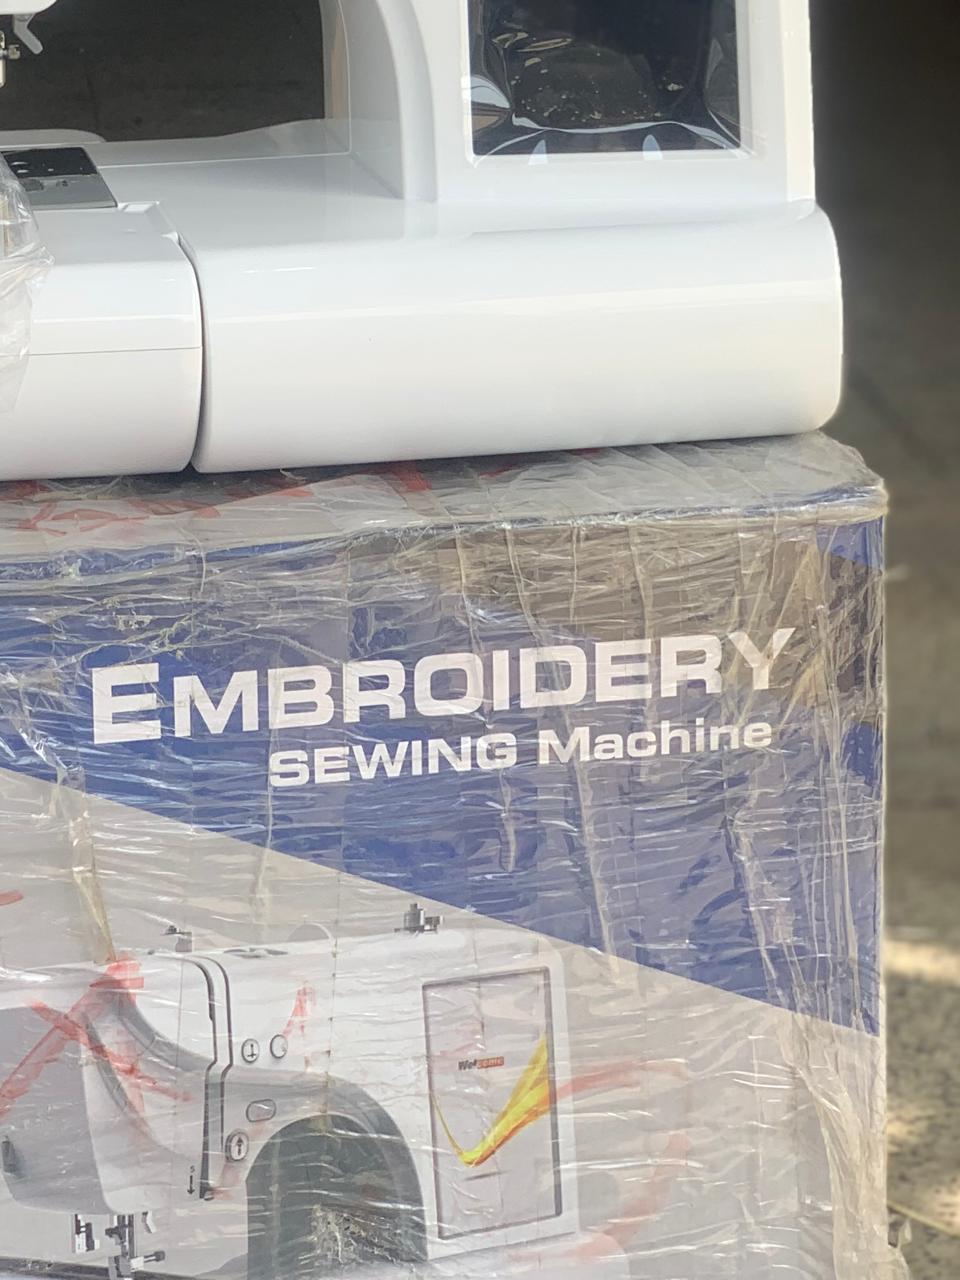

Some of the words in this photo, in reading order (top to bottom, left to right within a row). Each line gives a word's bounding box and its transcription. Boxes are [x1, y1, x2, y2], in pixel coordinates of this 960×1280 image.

[92, 627, 796, 745] EMBROIDERY
[268, 732, 517, 788] SEWING
[539, 717, 773, 765] Machine
